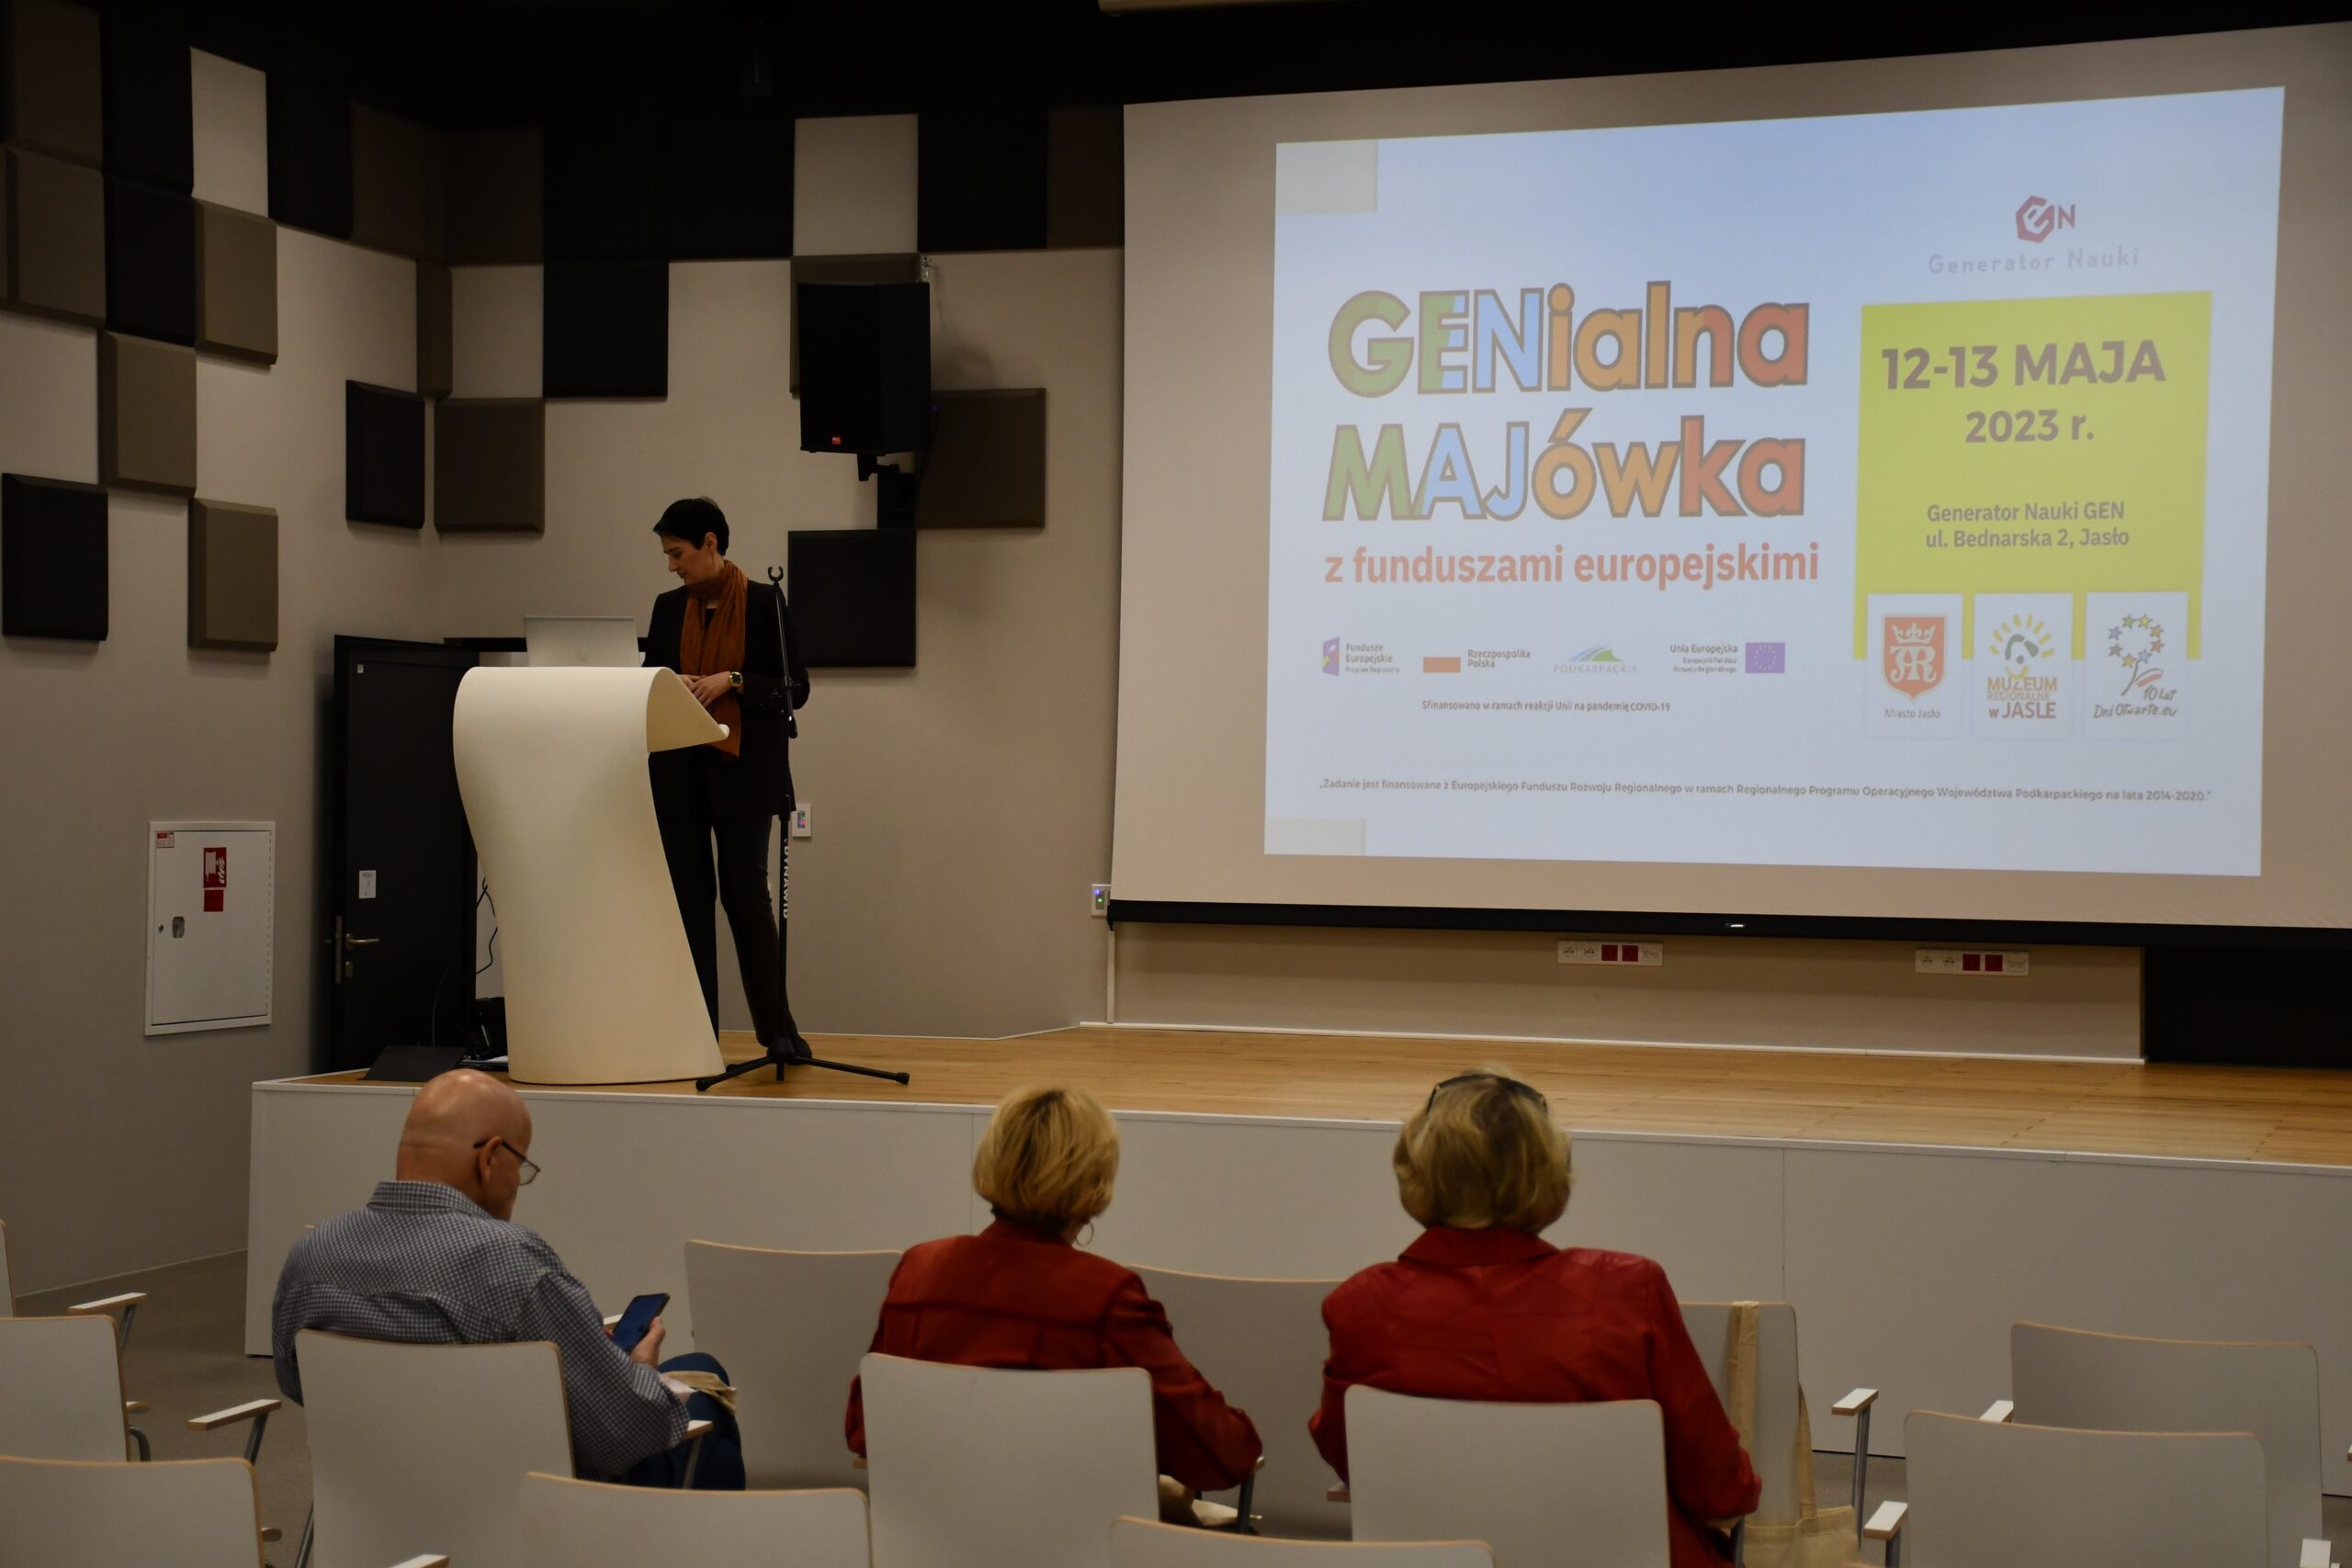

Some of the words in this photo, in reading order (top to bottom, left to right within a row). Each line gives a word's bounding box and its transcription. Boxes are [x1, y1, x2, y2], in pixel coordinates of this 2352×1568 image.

[1928, 253, 2054, 274] Generator
[2067, 245, 2139, 268] Nauki
[1328, 281, 1810, 398] GENialna
[1882, 345, 1998, 389] 12-13
[2015, 340, 2166, 386] MAJA
[1965, 410, 2059, 443] 2023
[2071, 414, 2095, 441] r.
[1322, 408, 1806, 521] MAJówka
[1927, 503, 2019, 523] Generator
[2024, 502, 2078, 521] Nauki
[2084, 502, 2125, 520] GEN
[1926, 530, 1948, 548] ul.
[1953, 528, 2052, 548] Bednarska
[2057, 529, 2075, 549] 2,
[2080, 528, 2130, 547] Jasło
[1325, 556, 1343, 582] z
[1353, 546, 1563, 582] funduszami
[1574, 543, 1819, 591] europejskimi
[1346, 643, 1384, 652] Fundusze
[1670, 644, 1690, 653] Unia
[1691, 644, 1737, 655] Europejska
[1346, 654, 1393, 664] Europejskie
[1468, 649, 1531, 660] Rzeczpospolita
[1468, 660, 1495, 668] Polska
[1553, 664, 1637, 673] PODKARPACKIE
[1987, 677, 2057, 691] MUZEUM
[1987, 691, 2051, 701] REGIONALNE
[2143, 685, 2158, 700] 10
[1422, 700, 1481, 710] Sfinansowano
[1491, 701, 1522, 710] ramach
[1524, 701, 1554, 712] reakcji
[1555, 701, 1572, 711] Unii
[1587, 702, 1629, 713] pandemię
[1630, 702, 1670, 712] COVID-19
[1884, 709, 1916, 718] Miasto
[1918, 708, 1940, 718] Jasło
[1989, 708, 1999, 718] w
[2093, 705, 2113, 718] Dni
[1363, 780, 1379, 790] jest
[1382, 780, 1441, 789] finansowane
[1451, 781, 1519, 792] Europejskiego
[1521, 782, 1567, 791] Funduszu
[1570, 782, 1611, 793] Rozwoju
[1614, 783, 1682, 795] Regionalnego
[1696, 784, 1734, 794] ramach
[1737, 784, 1806, 796] Regionalnego
[1808, 785, 1860, 796] Programu
[1862, 786, 1935, 798] Operacyjnego
[1937, 787, 2013, 799] Województwa
[2015, 788, 2103, 801] Podkarpackiego
[2122, 790, 2143, 800] lata
